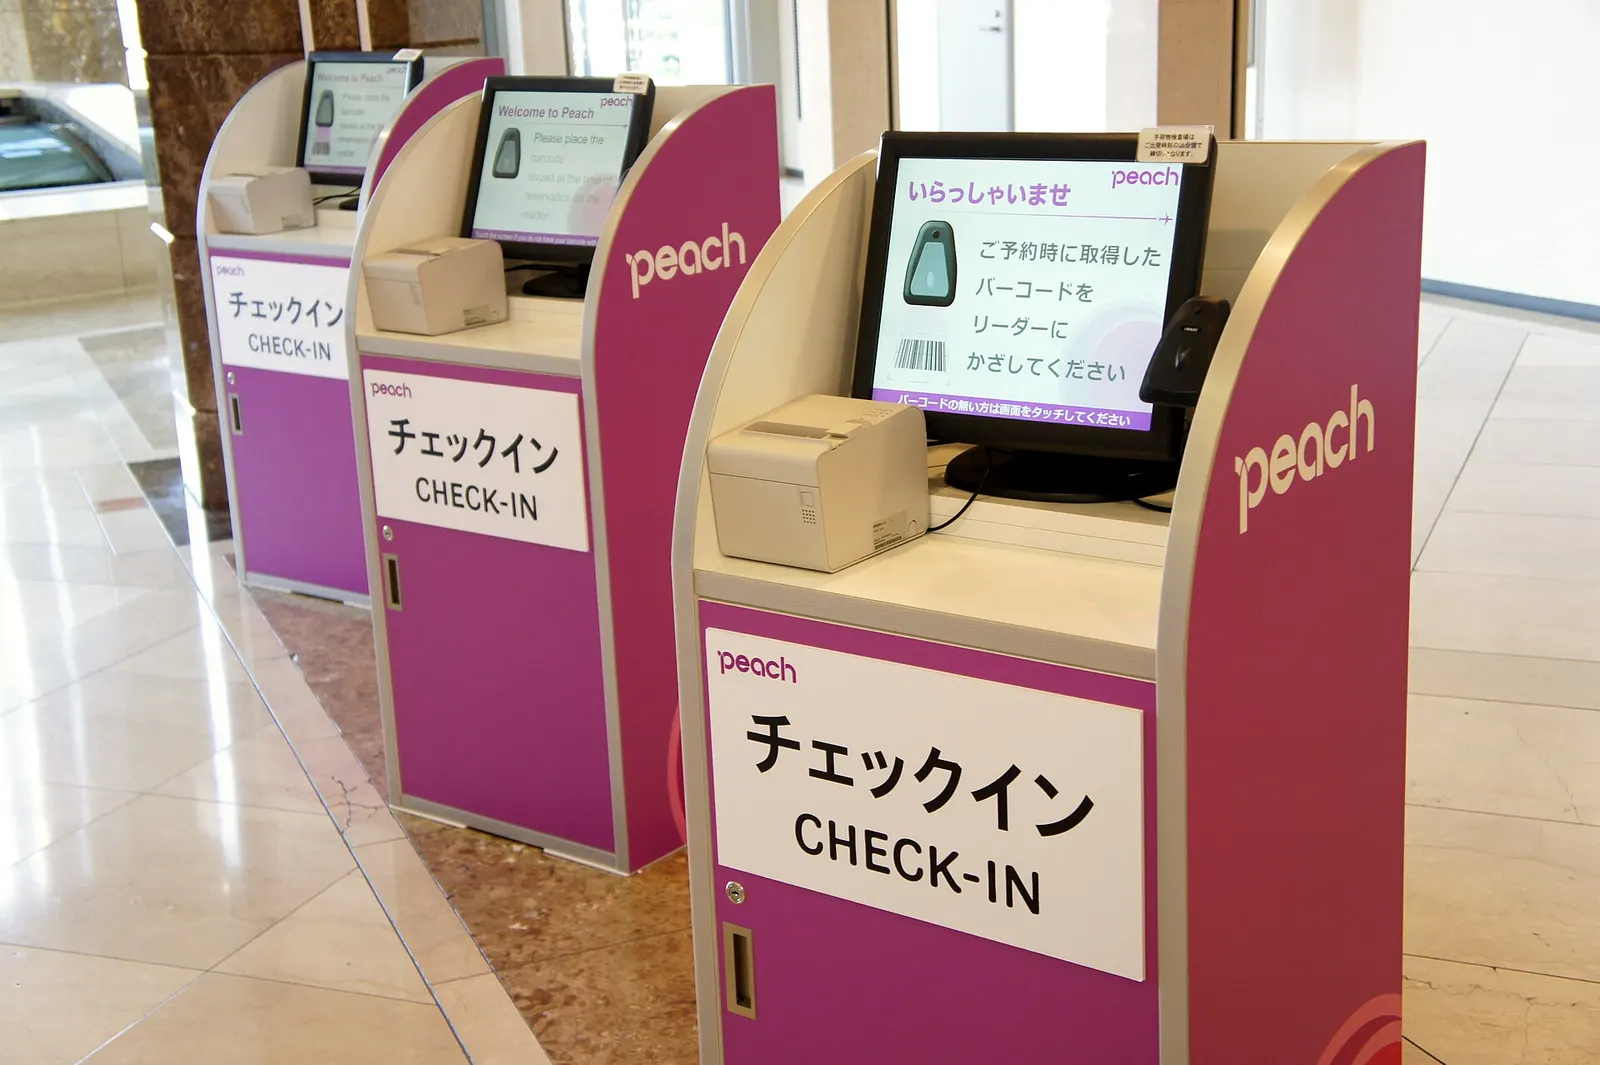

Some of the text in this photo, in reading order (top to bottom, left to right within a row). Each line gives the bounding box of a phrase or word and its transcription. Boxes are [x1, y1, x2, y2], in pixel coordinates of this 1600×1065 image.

[316, 73, 383, 83] Welcome to Peach
[498, 105, 595, 119] Welcome to Peach
[600, 96, 633, 109] peach
[533, 132, 604, 146] Please place the
[530, 153, 565, 164] barcode
[1111, 167, 1180, 189] peach
[908, 181, 1072, 207] いらっしゃいませ
[520, 210, 549, 220] reader
[625, 221, 747, 299] peach
[980, 240, 1162, 267] ご予約時に取得した
[216, 265, 244, 276] peach
[975, 278, 1094, 302] バーコードを
[228, 291, 344, 328] チェックイン
[973, 315, 1069, 339] リーダーに
[248, 333, 332, 361] CHECK-IN
[967, 352, 1126, 381] かざしてください
[370, 382, 412, 399] peach
[898, 394, 1131, 427] バーコードの無い方は画面をタッチしてください
[388, 418, 559, 474] チェックイン
[1234, 383, 1375, 535] peach
[415, 477, 538, 521] CHECK-IN
[717, 649, 797, 684] peach
[746, 713, 1095, 838] チェックイン
[794, 812, 1040, 915] CHECK-IN
